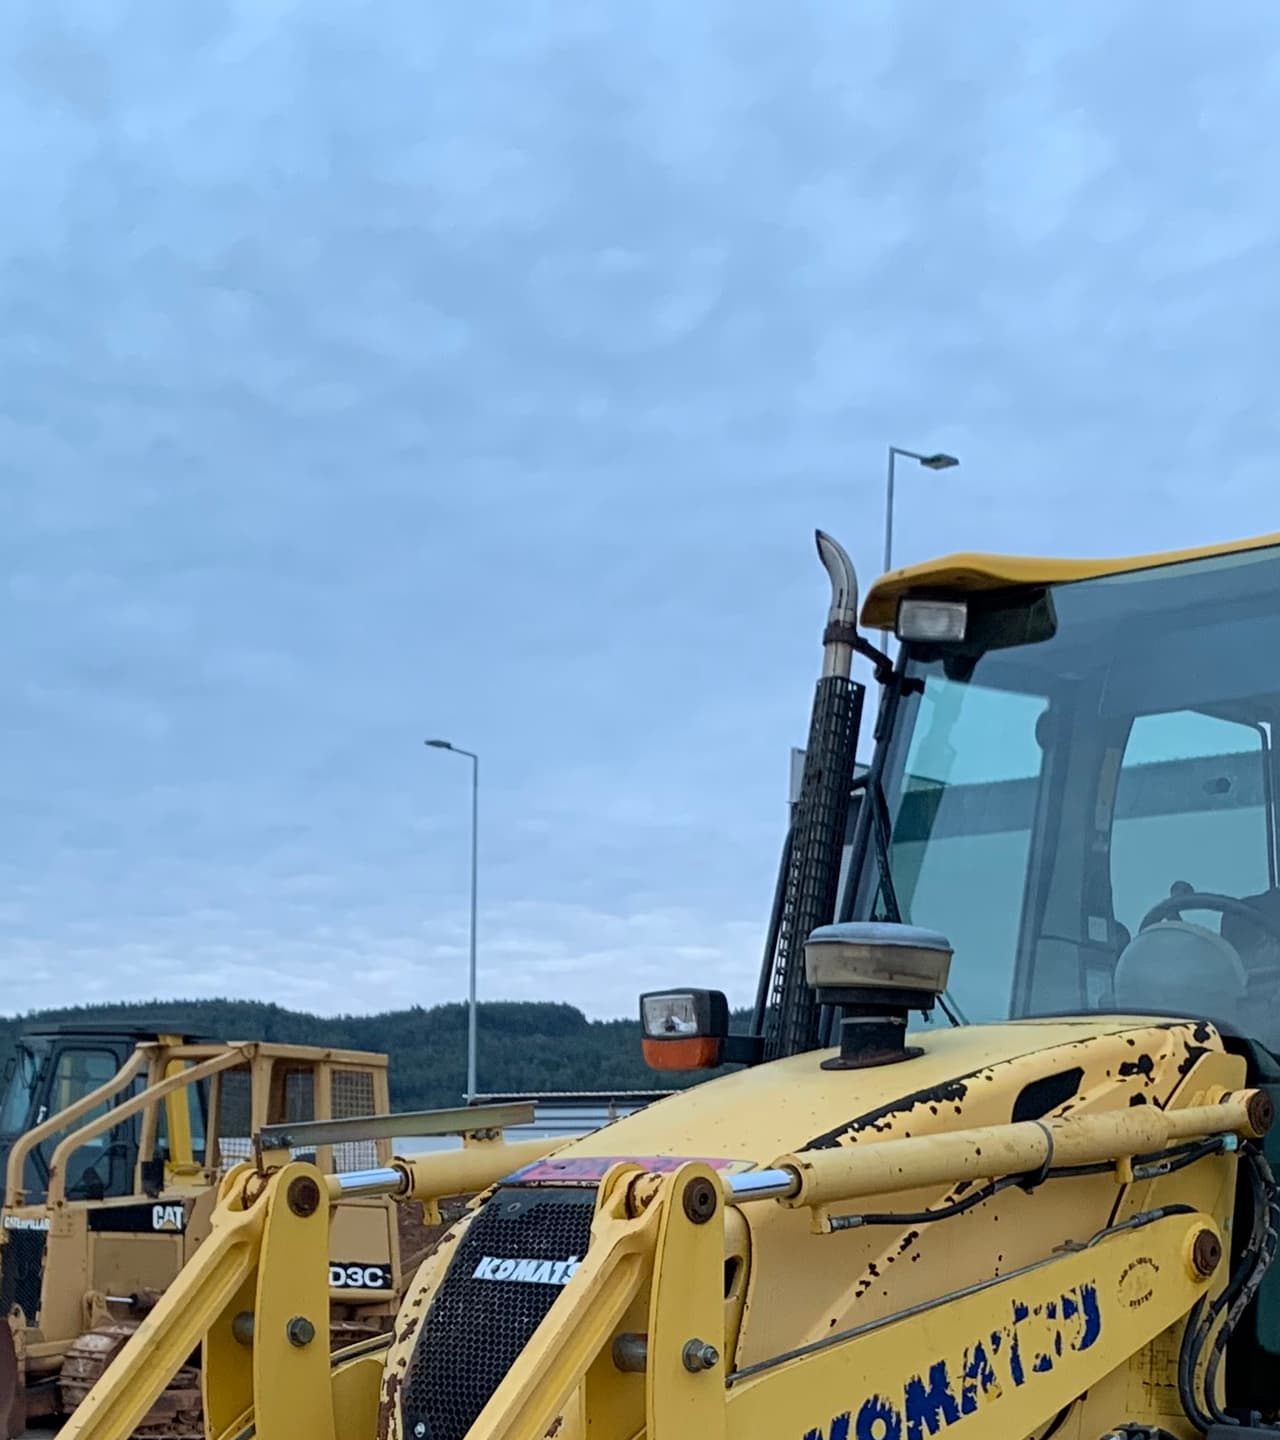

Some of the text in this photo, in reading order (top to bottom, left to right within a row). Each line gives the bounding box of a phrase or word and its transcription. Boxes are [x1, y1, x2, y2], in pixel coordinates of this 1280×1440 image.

[152, 1205, 184, 1230] CAT
[328, 1266, 384, 1287] D3C
[472, 1255, 582, 1286] KOMATS
